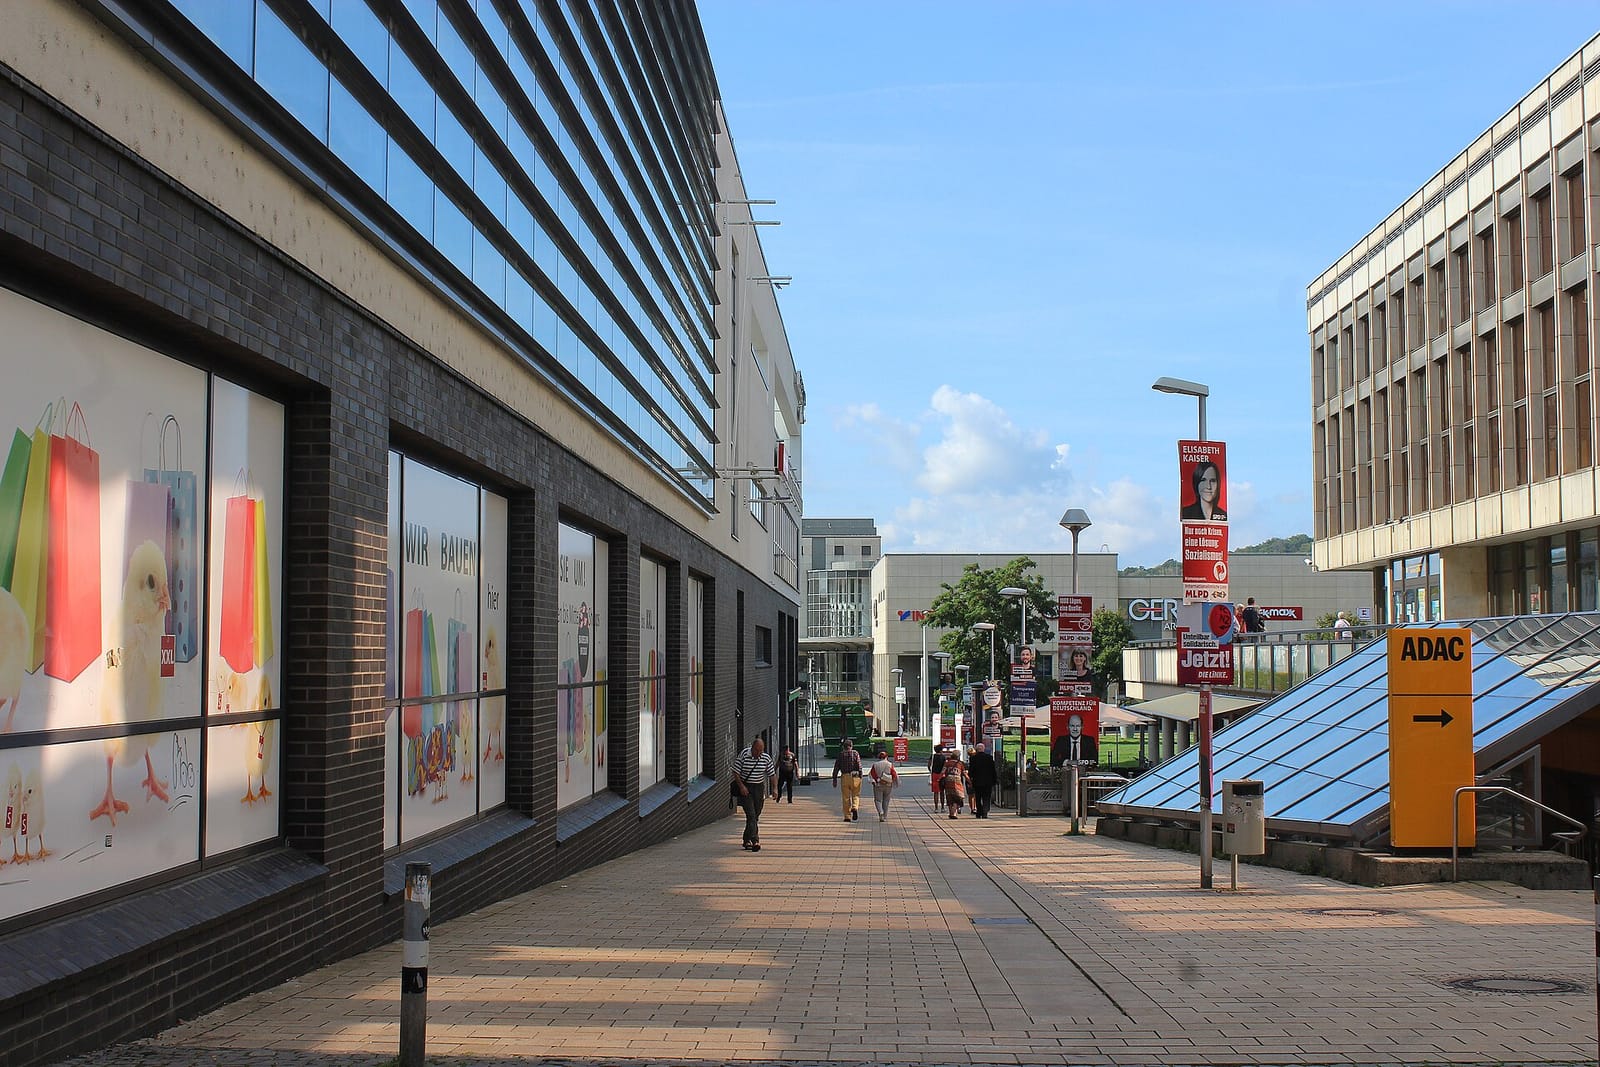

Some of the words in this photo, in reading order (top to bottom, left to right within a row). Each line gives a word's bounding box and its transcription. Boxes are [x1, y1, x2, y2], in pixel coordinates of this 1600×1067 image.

[1182, 445, 1220, 455] ELISABETH
[1183, 454, 1209, 463] KAISER
[1184, 537, 1198, 547] eine
[405, 521, 429, 567] WIR
[441, 532, 476, 577] BAUEN
[560, 553, 569, 583] SIE
[487, 583, 500, 610] hier
[1185, 590, 1208, 599] MLPD
[1128, 598, 1178, 621] GER
[1183, 632, 1210, 640] Unteilbar
[1183, 640, 1217, 648] solidarisch.
[1401, 636, 1464, 662] ADAC
[161, 649, 174, 665] XXL
[1181, 650, 1230, 669] Jetzt!
[1198, 670, 1209, 679] DIE
